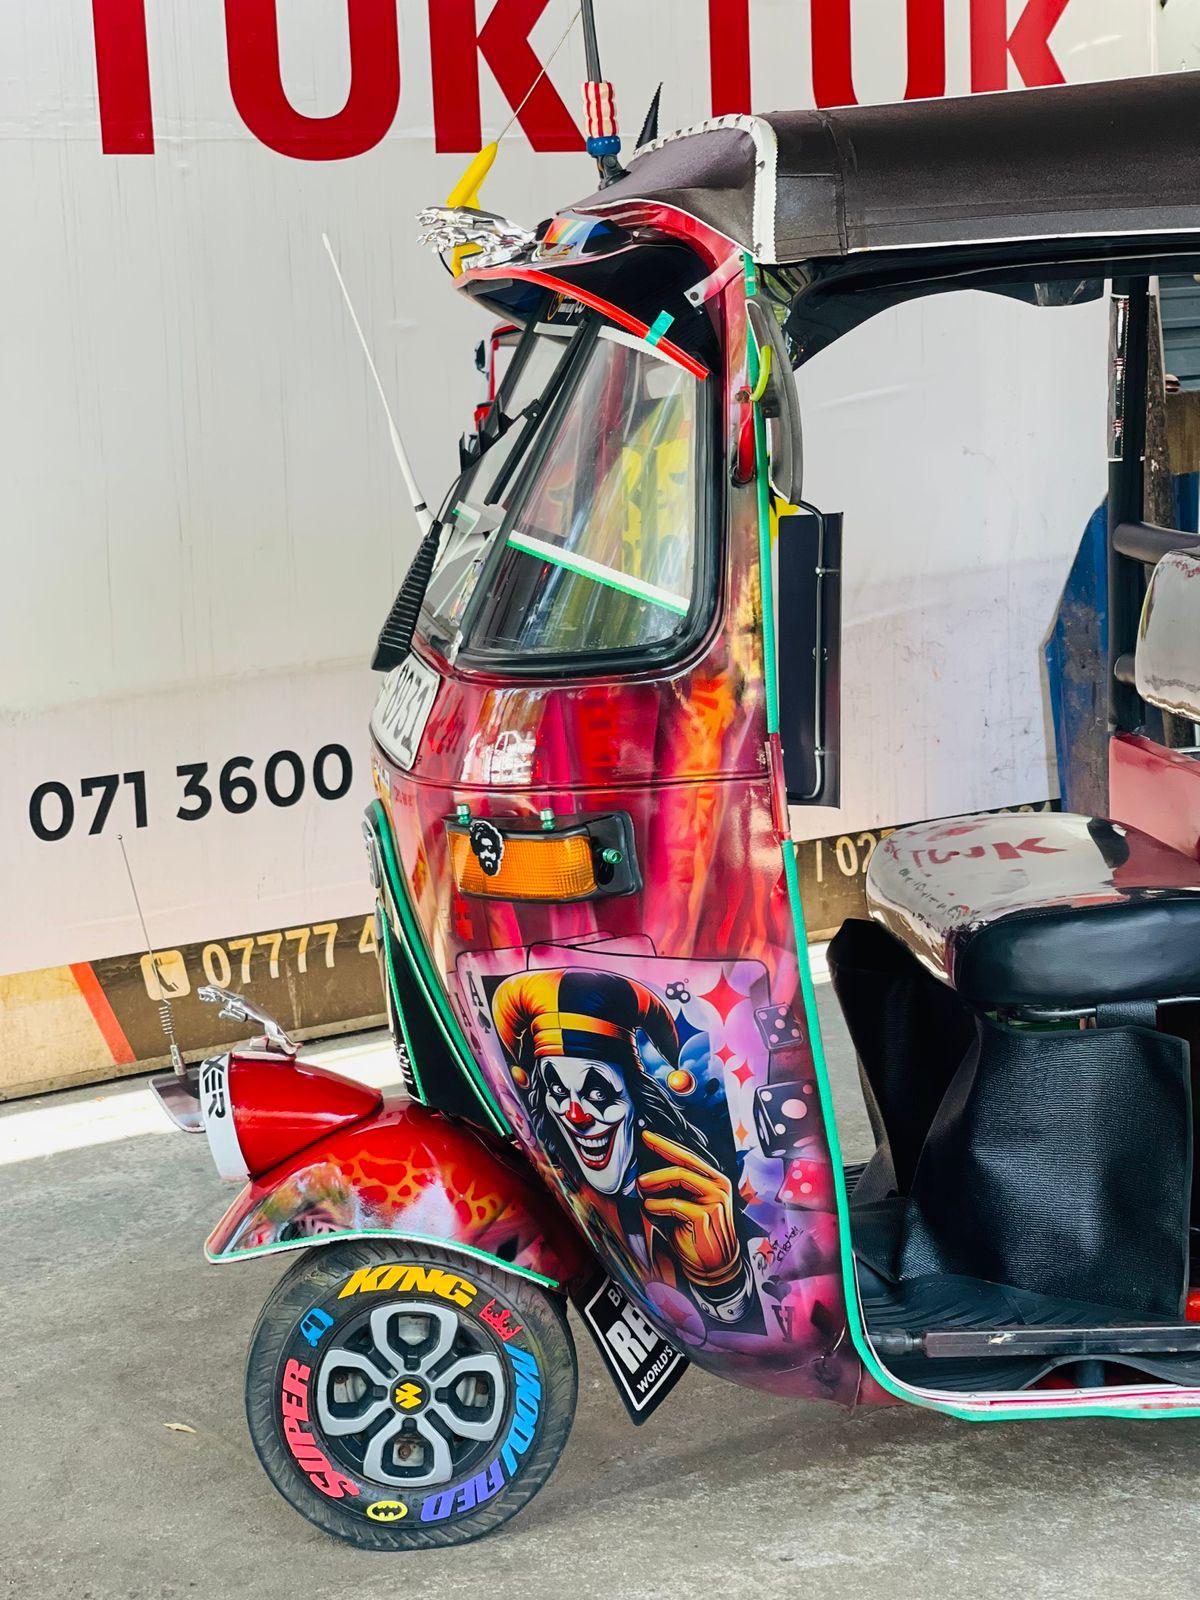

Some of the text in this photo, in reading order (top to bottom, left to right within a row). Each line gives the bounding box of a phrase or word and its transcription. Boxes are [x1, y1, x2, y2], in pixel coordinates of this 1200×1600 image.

[29, 743, 353, 841] 071 3600
[835, 828, 898, 877] 02
[202, 922, 338, 989] 07777
[337, 1264, 478, 1308] KING
[636, 1344, 674, 1394] WORLD'S
[281, 1357, 361, 1499] SUPER
